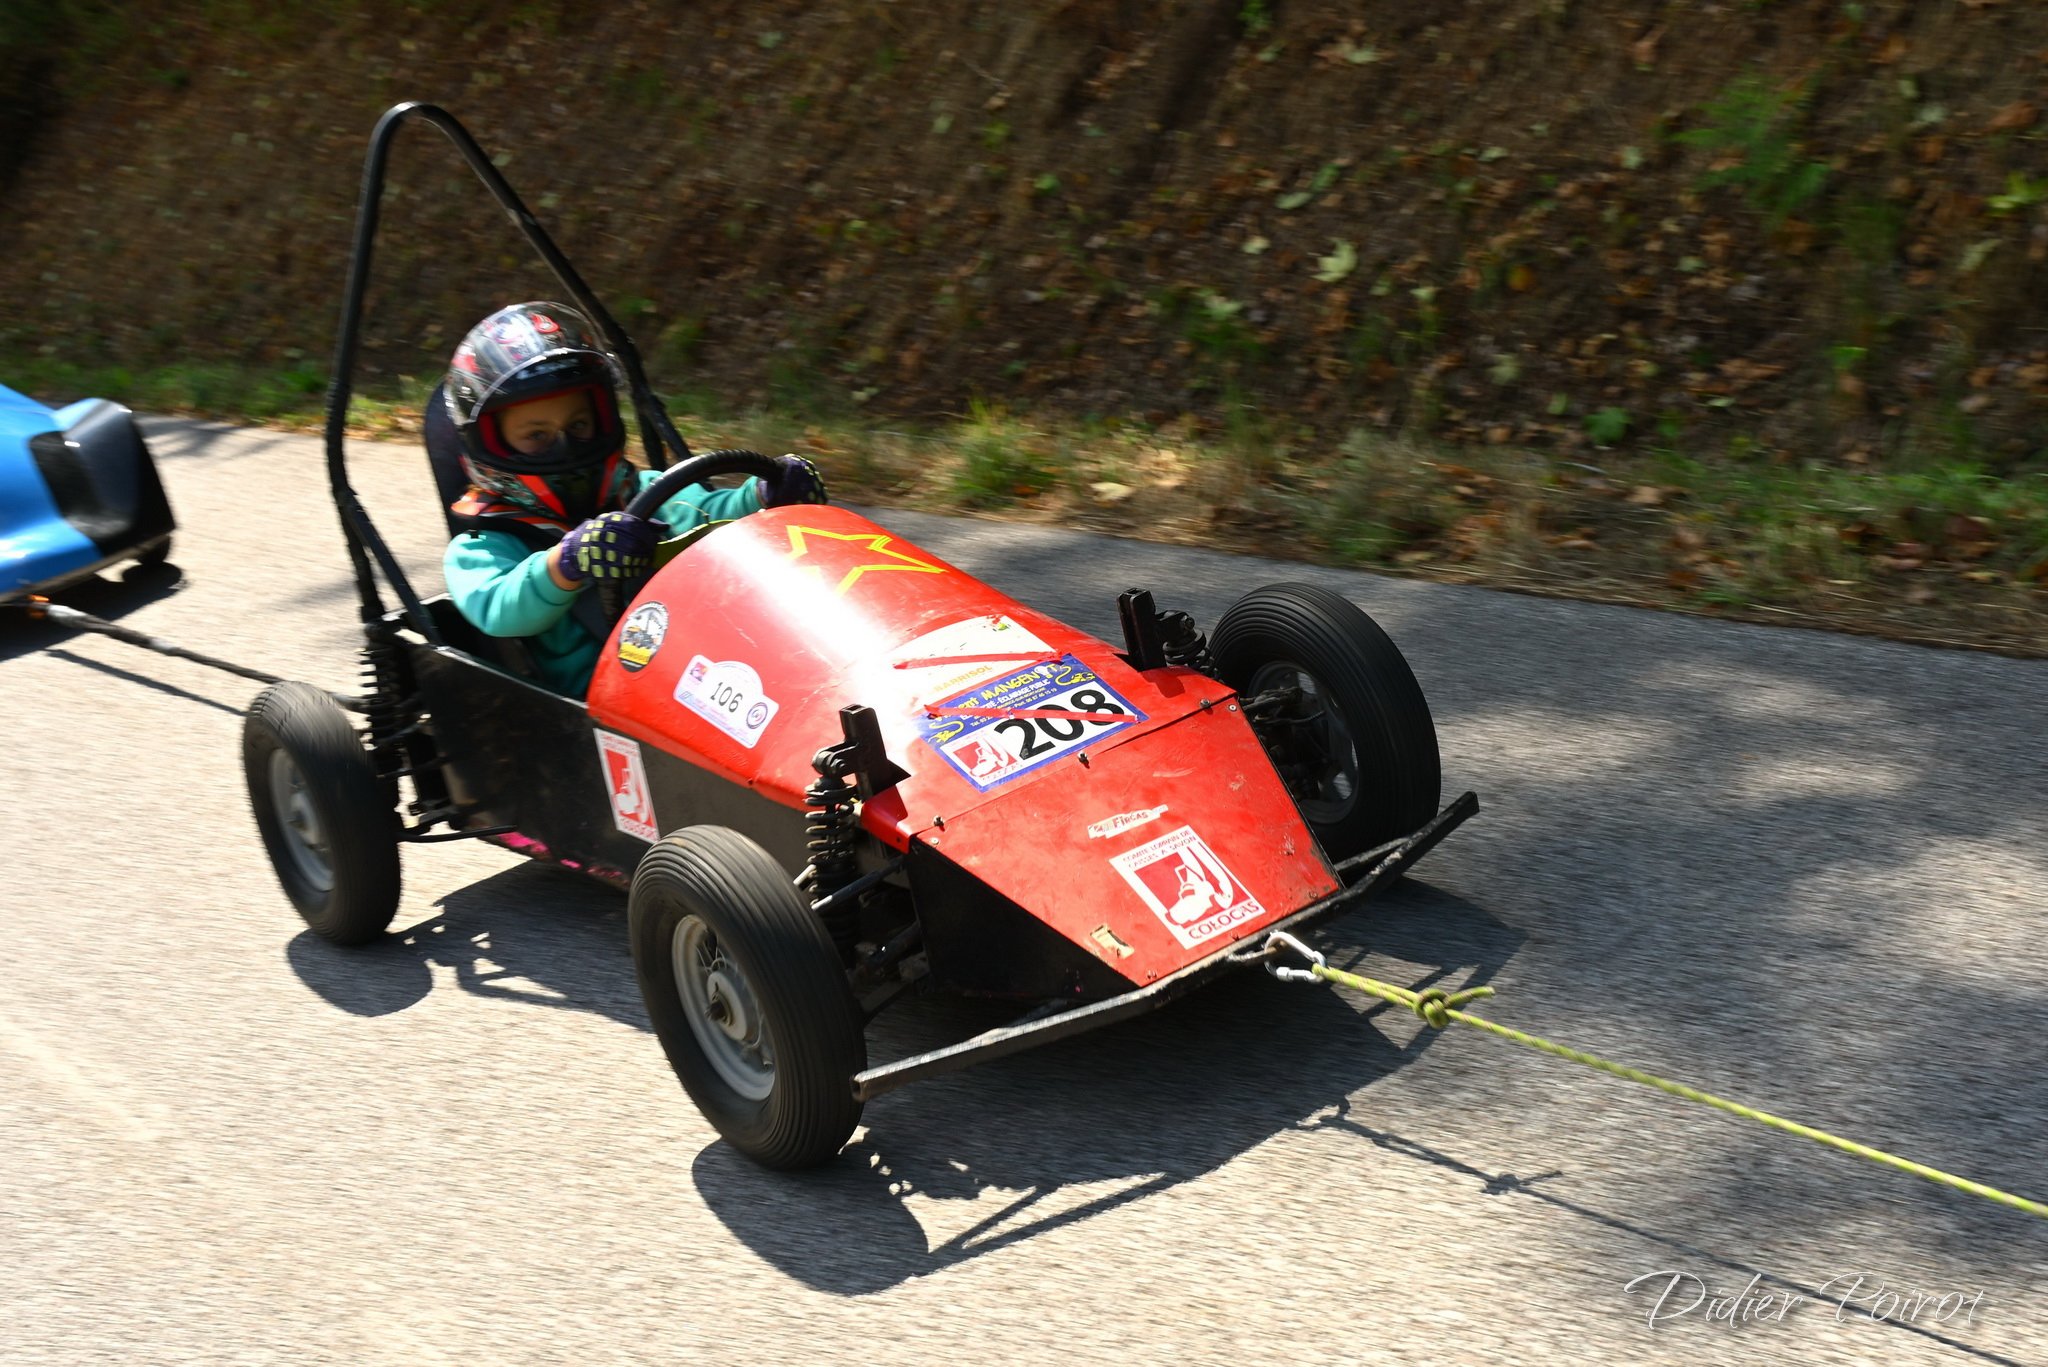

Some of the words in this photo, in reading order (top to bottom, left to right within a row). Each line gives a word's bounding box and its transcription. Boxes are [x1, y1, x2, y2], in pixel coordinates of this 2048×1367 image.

[933, 665, 993, 691] BARRISOL
[1029, 677, 1051, 690] PUBLIC
[710, 682, 743, 713] 106
[994, 689, 1125, 760] 208
[1171, 835, 1196, 850] SAVON
[1180, 829, 1191, 837] DE
